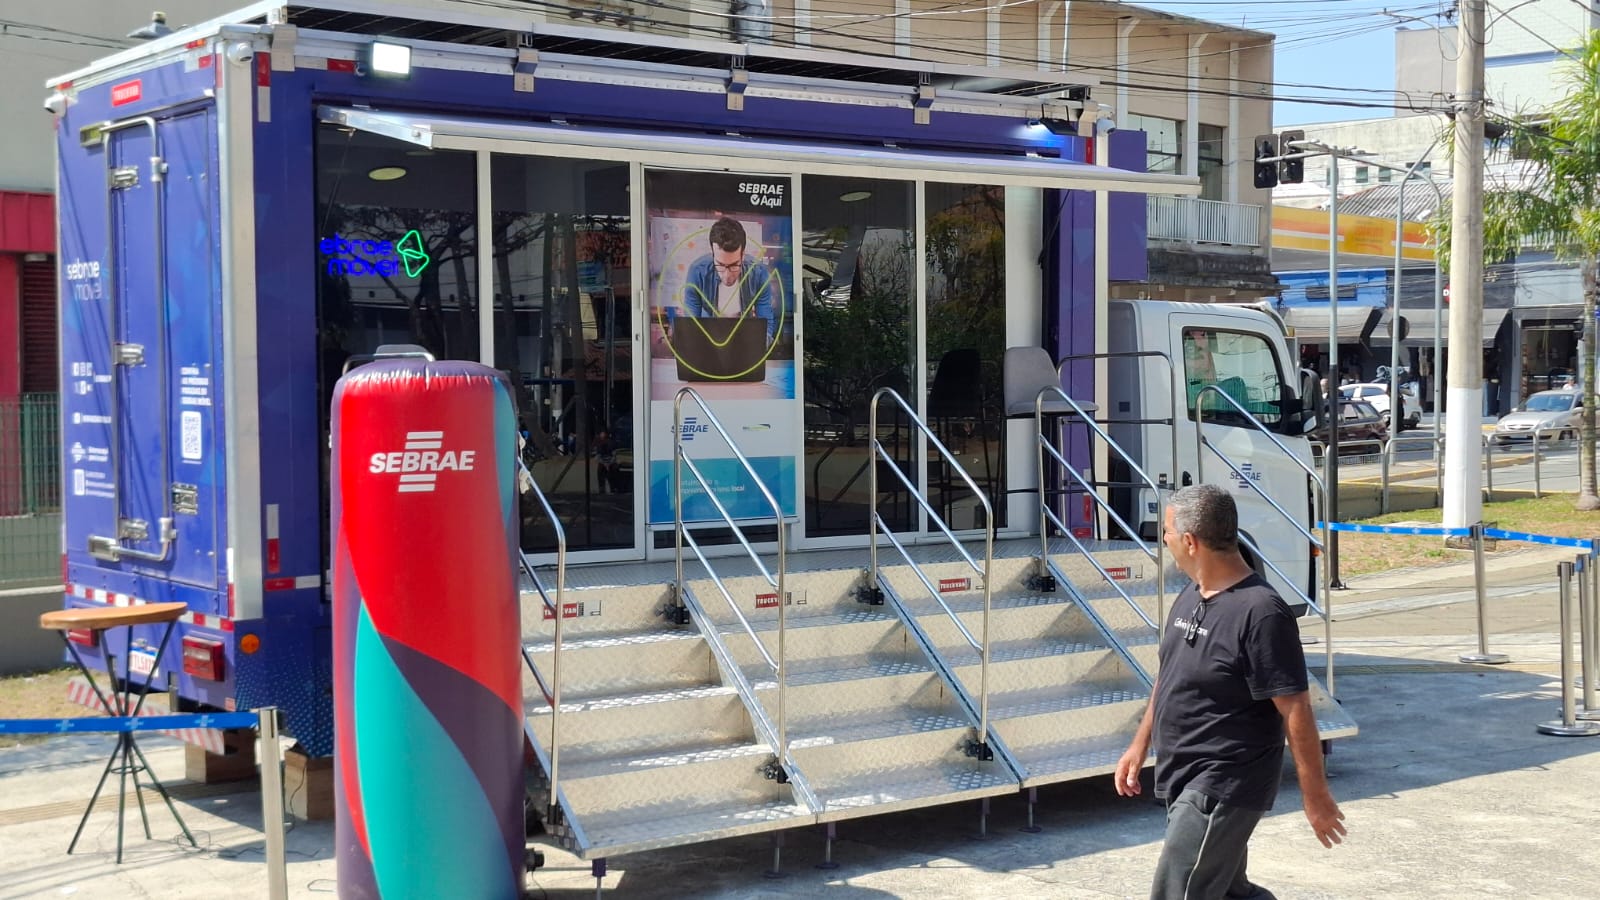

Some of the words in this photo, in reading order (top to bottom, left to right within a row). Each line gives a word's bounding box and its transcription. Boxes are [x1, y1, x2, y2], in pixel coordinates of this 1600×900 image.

[738, 182, 784, 195] SEBRAE
[760, 194, 783, 209] Aqui
[319, 232, 394, 256] ebrae
[369, 450, 476, 474] SEBRAE
[1229, 471, 1262, 481] SERAE
